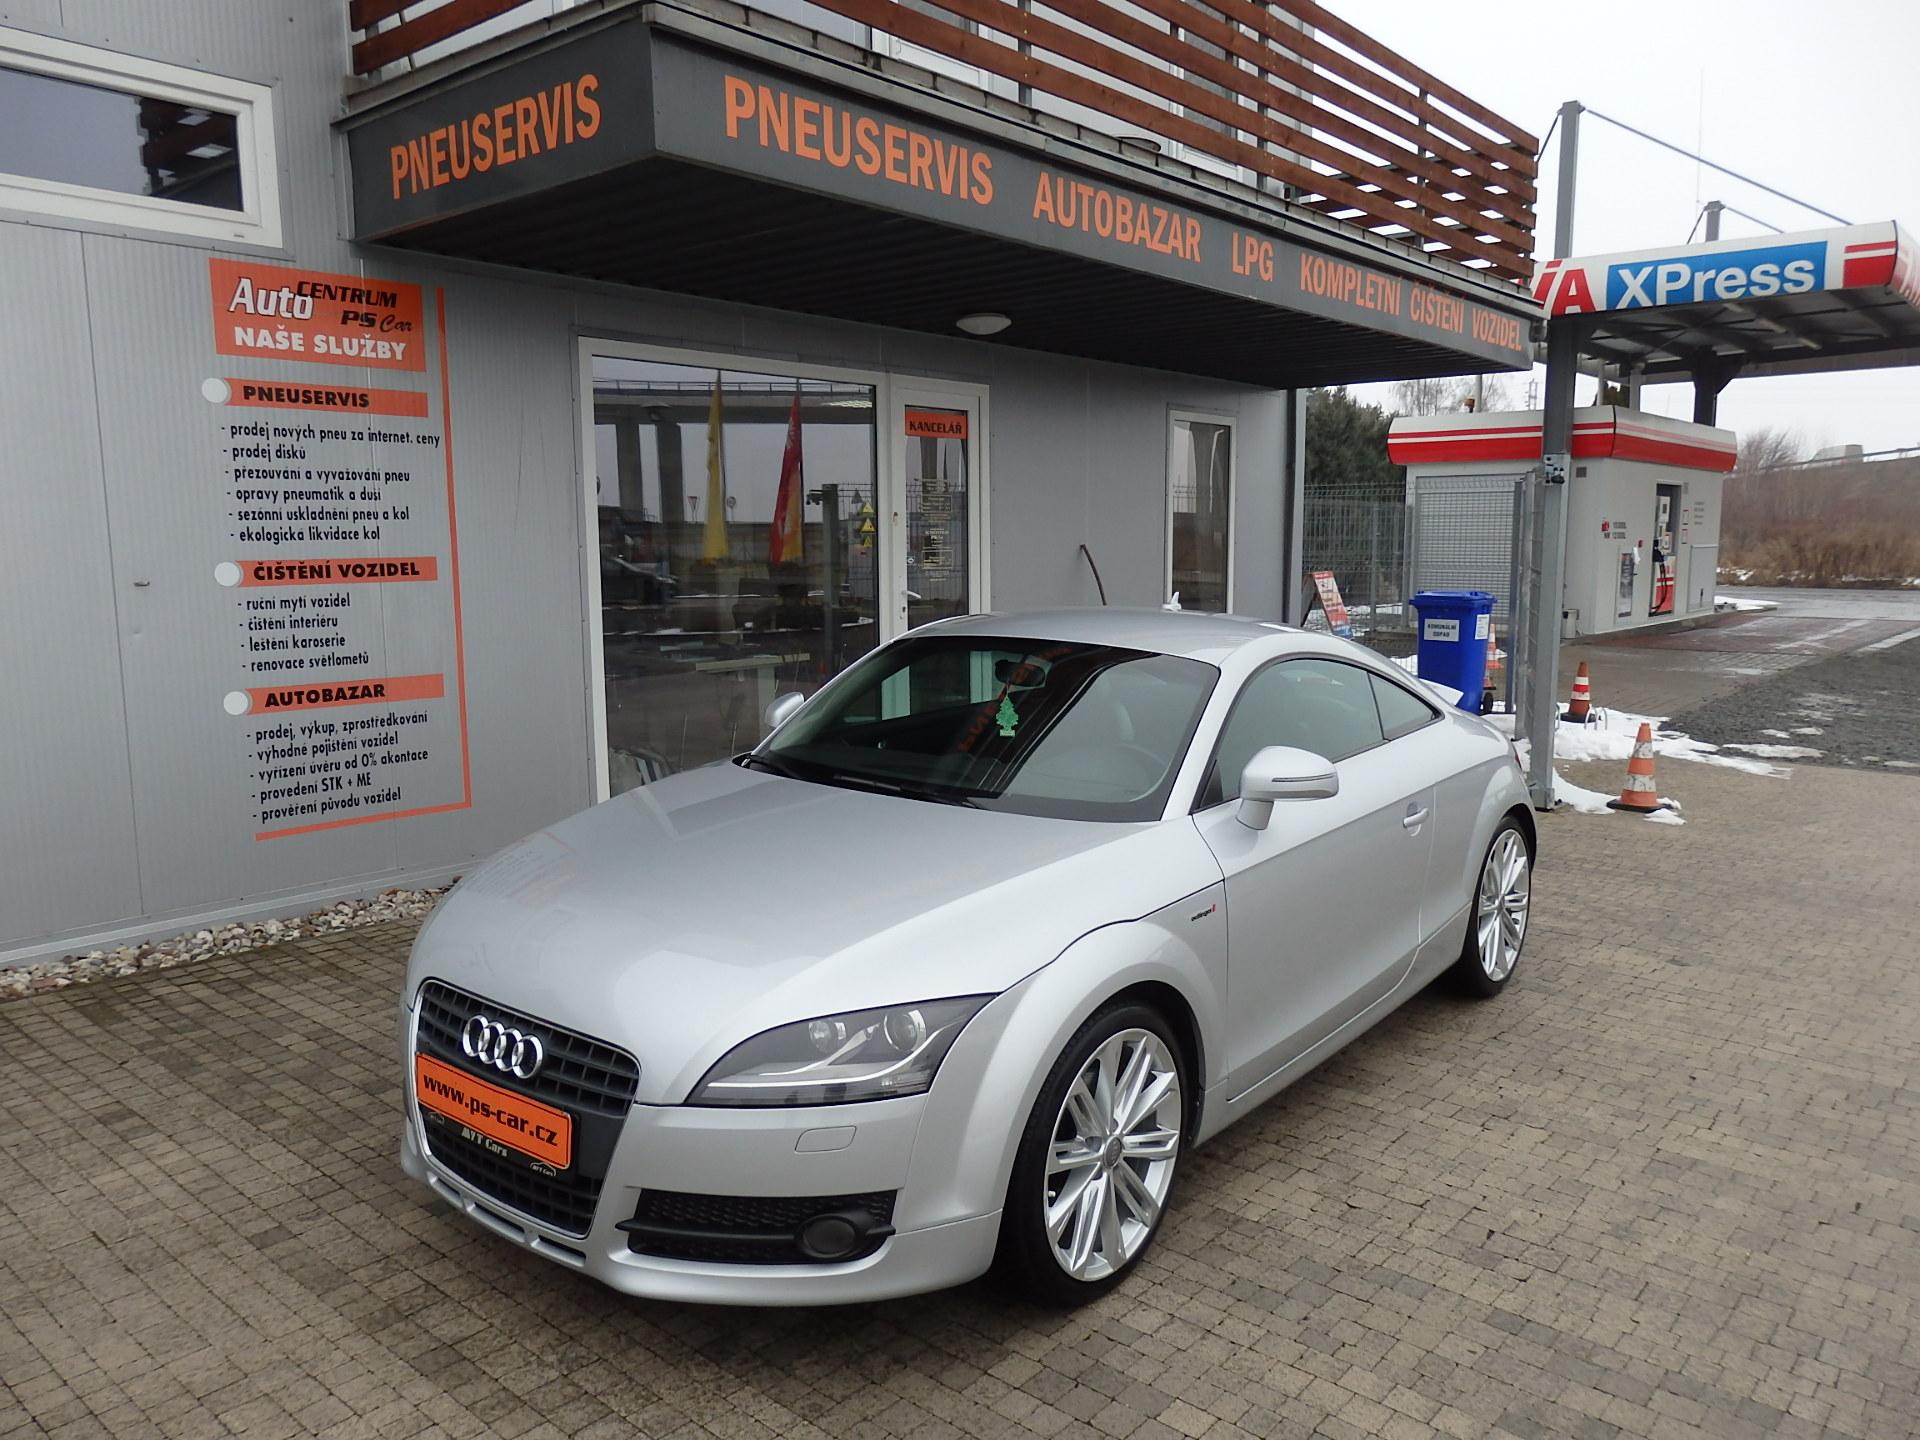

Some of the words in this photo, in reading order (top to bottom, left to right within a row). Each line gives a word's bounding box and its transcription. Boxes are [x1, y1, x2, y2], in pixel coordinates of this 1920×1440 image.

[391, 73, 601, 199] PNEUSERVIS
[724, 74, 994, 206] PNEUSERVIS
[1033, 171, 1201, 263] AUTOBAZAR
[1231, 232, 1274, 282] LPG
[1410, 278, 1465, 334] ČIŠTĚNÍ
[1472, 306, 1522, 352] VOZIDEL
[1615, 259, 1816, 310] XPress
[228, 276, 314, 321] Auto
[296, 281, 398, 309] CENTRUM
[340, 310, 377, 328] PS
[379, 314, 413, 332] Car
[234, 324, 305, 352] NAŠE
[313, 333, 407, 361] SLUŽBY
[243, 385, 370, 408] PNEUSERVIS
[231, 421, 270, 441] prodej
[273, 424, 316, 442] nových
[320, 430, 347, 443] pneu
[351, 431, 364, 441] za
[368, 426, 414, 444] internet.
[416, 434, 441, 449] ceny
[232, 442, 272, 463] prodej
[275, 443, 306, 460] disků
[234, 465, 301, 483] přezouvání
[305, 470, 313, 480] a
[317, 468, 381, 485] vyvažování
[384, 471, 410, 485] pneu
[236, 489, 279, 504] opravy
[283, 486, 345, 504] pneumatik
[349, 491, 356, 501] a
[360, 486, 381, 501] duší
[238, 506, 283, 521] sezónní
[287, 506, 349, 521] uskladnění
[352, 511, 379, 524] pneu
[382, 511, 389, 520] a
[393, 506, 410, 520] kol
[240, 526, 304, 545] ekologická
[309, 525, 359, 541] likvidace
[363, 525, 380, 540] kol
[253, 560, 332, 580] ČIŠTĚNÍ
[337, 562, 420, 578] VOZIDEL
[246, 596, 277, 611] ruční
[280, 595, 307, 612] mytí
[311, 592, 351, 608] vozidel
[248, 615, 286, 631] čištění
[289, 613, 339, 629] interiéru
[249, 636, 289, 652] leštění
[292, 632, 346, 649] karoserie
[251, 658, 305, 672] renovace
[309, 651, 370, 669] světlometů
[264, 683, 386, 708] AUTOBAZAR
[256, 722, 296, 745] prodej,
[300, 720, 338, 740] výkup,
[342, 710, 429, 734] zprostředkování
[257, 742, 308, 764] výhodné
[312, 735, 358, 758] pojištění
[361, 730, 399, 748] vozidel
[259, 761, 306, 784] vyřízení
[310, 760, 341, 774] úvěru
[344, 753, 358, 769] od
[361, 752, 378, 768] 0%
[381, 750, 429, 765] akontace
[260, 780, 318, 805] provedení
[321, 775, 343, 793] STK
[356, 772, 372, 787] ME
[262, 799, 318, 825] prověření
[320, 793, 361, 815] původu
[363, 786, 402, 805] vozidel
[423, 1074, 559, 1147] www.ps-car.cz
